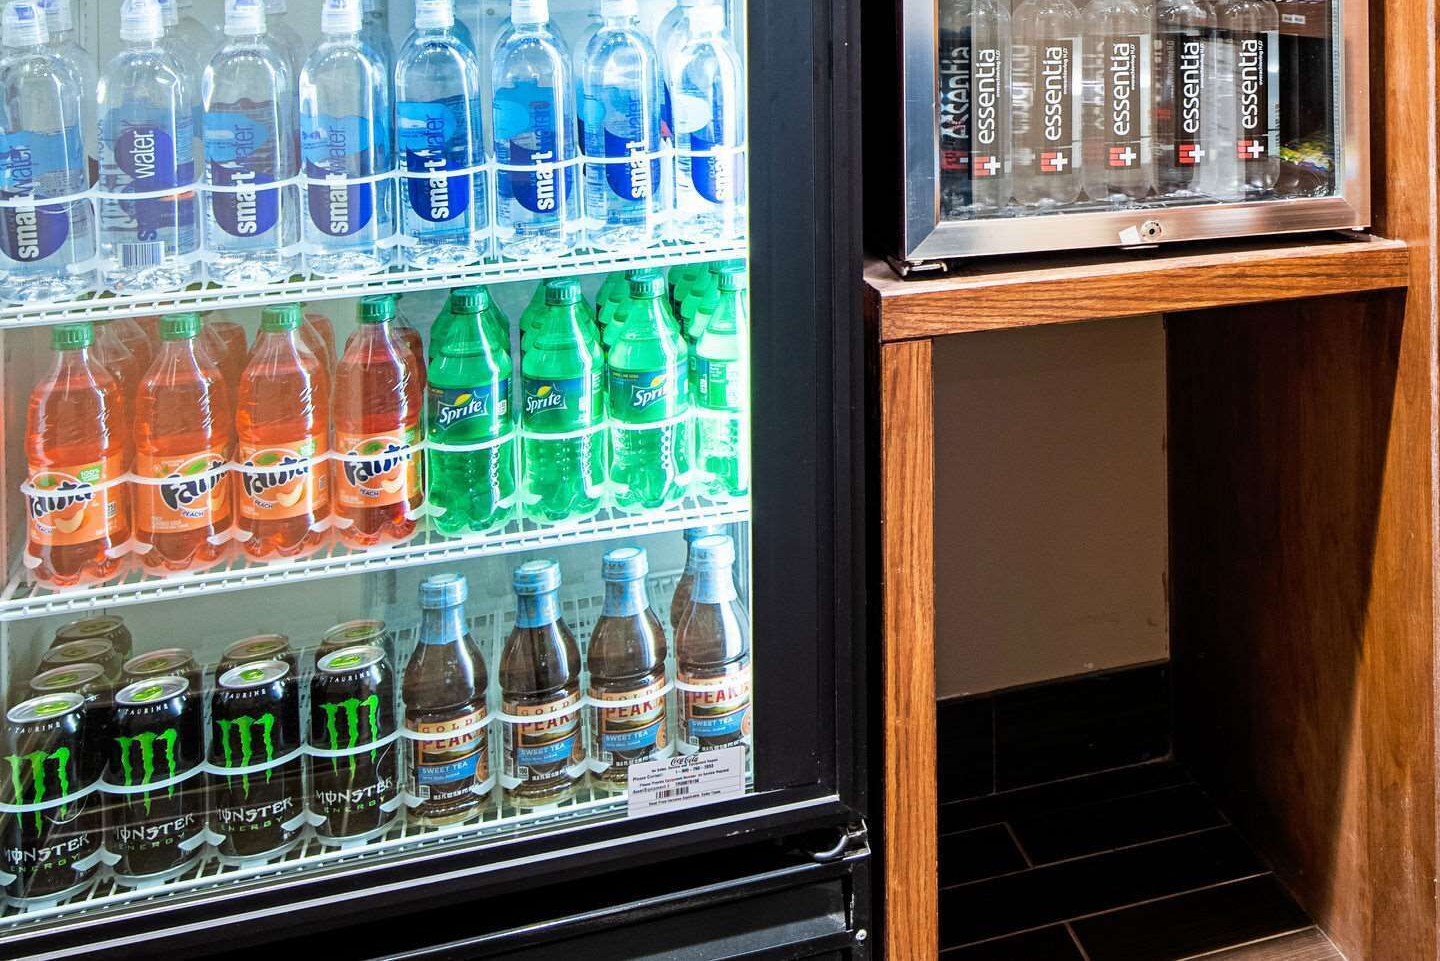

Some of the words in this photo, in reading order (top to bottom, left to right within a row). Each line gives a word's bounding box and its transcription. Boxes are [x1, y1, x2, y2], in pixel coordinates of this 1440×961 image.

[975, 48, 995, 144] essentia
[1041, 46, 1062, 141] essentia
[1110, 43, 1130, 136] essentia
[1179, 42, 1200, 134] essentia
[1238, 39, 1258, 130] essentia
[424, 158, 449, 220] smart
[438, 397, 485, 426] Sprite
[525, 393, 563, 414] Sprite
[181, 509, 204, 519] PEACH
[225, 688, 266, 700] TAURINE
[606, 733, 631, 743] SWEET
[633, 730, 650, 739] TEA
[421, 764, 449, 775] SWEET
[452, 761, 469, 770] TEA
